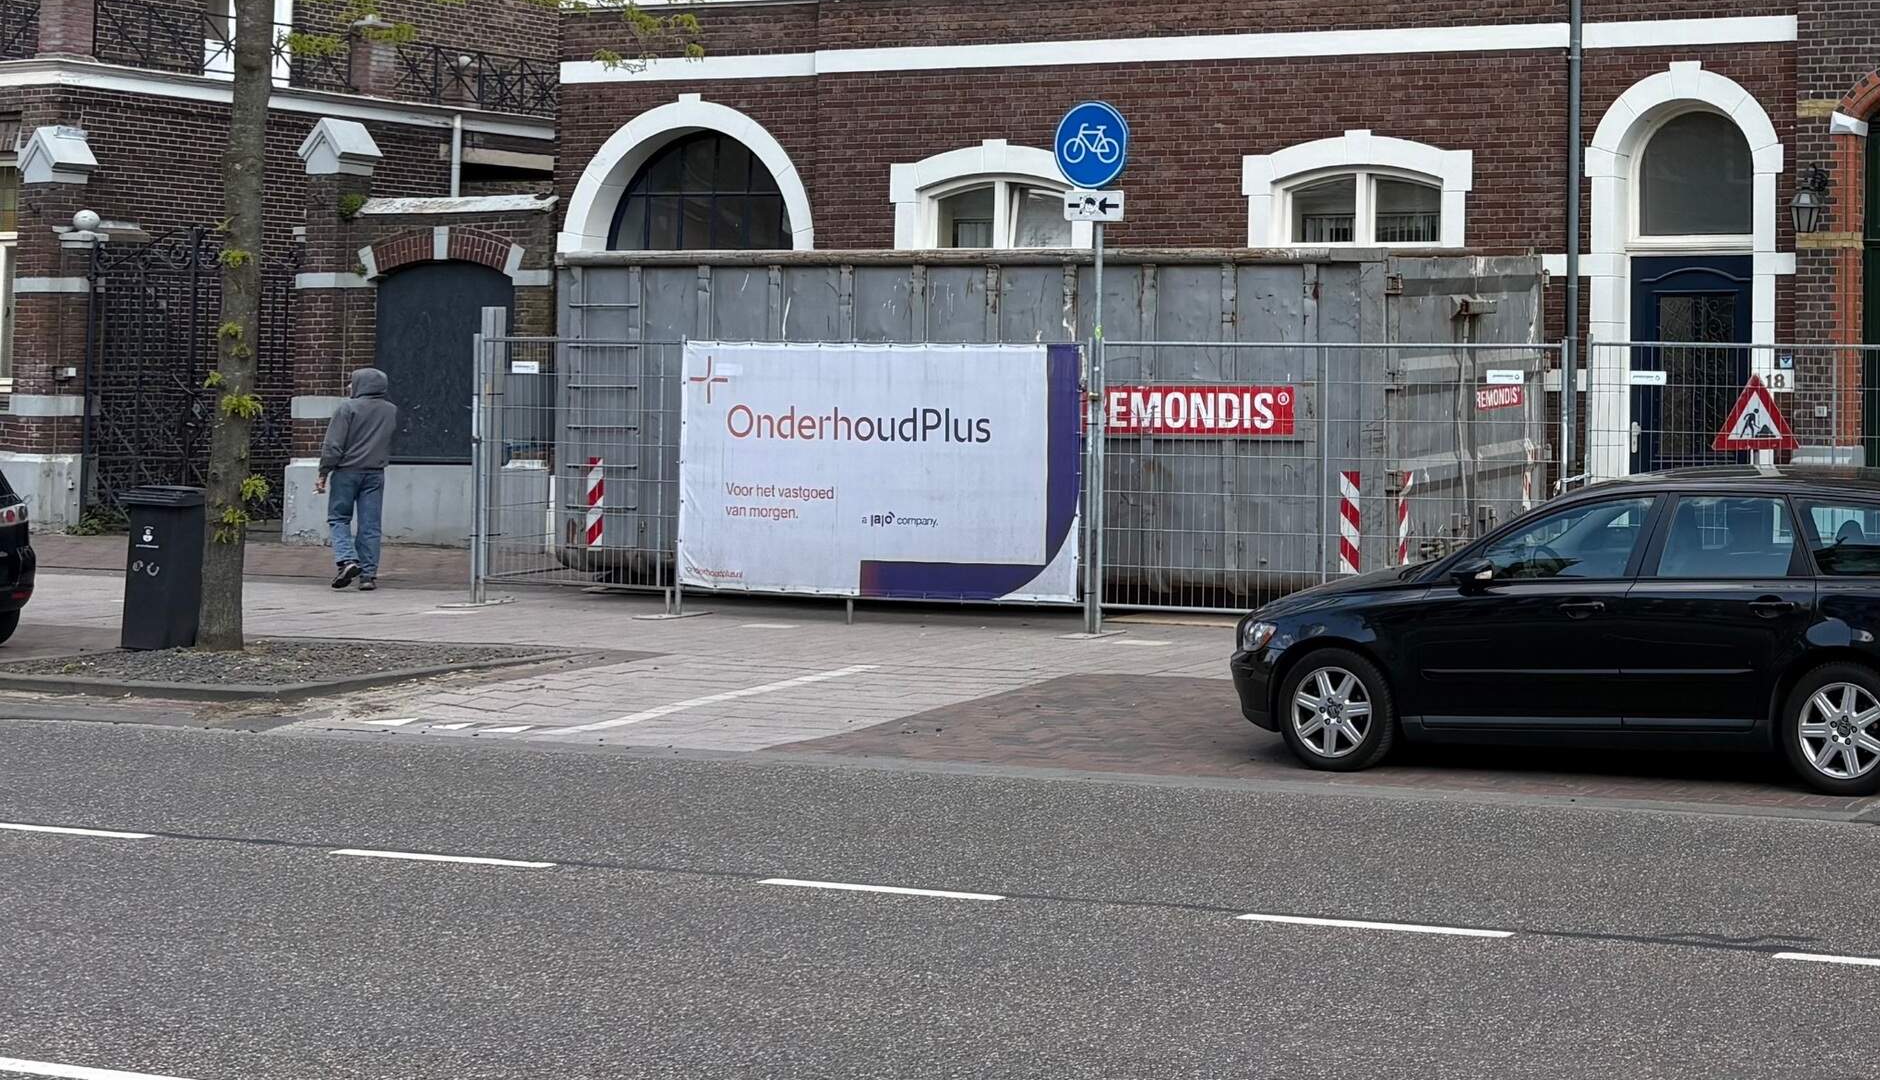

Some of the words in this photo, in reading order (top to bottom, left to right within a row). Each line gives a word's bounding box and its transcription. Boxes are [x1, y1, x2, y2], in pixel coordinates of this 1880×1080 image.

[1766, 374, 1785, 389] 18
[727, 404, 991, 443] OnderhoudPlus
[726, 482, 753, 497] Voor
[756, 483, 776, 498] het
[778, 485, 835, 502] vastgoed
[726, 505, 747, 517] van
[749, 507, 799, 521] morgen.
[861, 516, 868, 524] a
